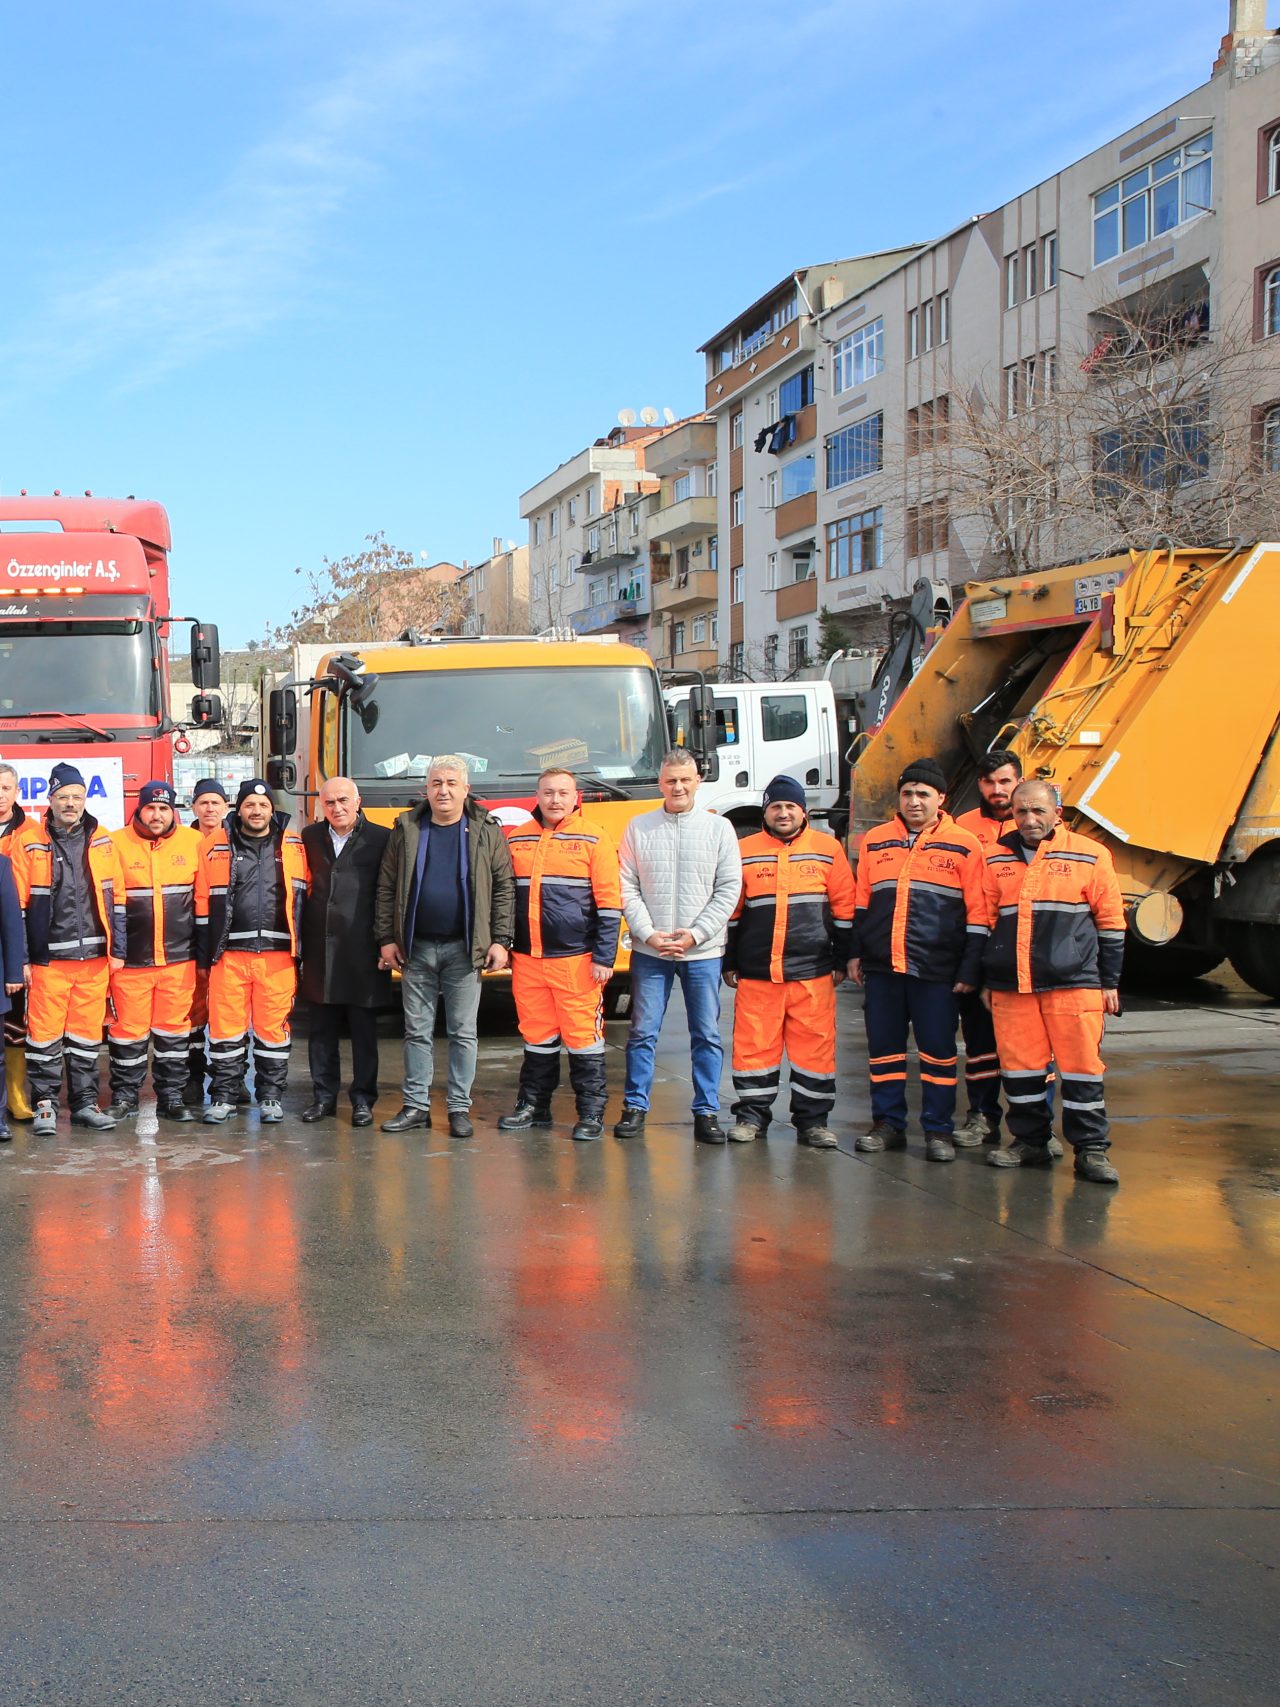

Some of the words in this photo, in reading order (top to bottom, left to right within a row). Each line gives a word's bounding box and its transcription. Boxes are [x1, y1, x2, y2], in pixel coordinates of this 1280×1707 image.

[95, 560, 120, 582] A.Ş.
[1078, 599, 1088, 611] 34
[1089, 596, 1099, 609] YB
